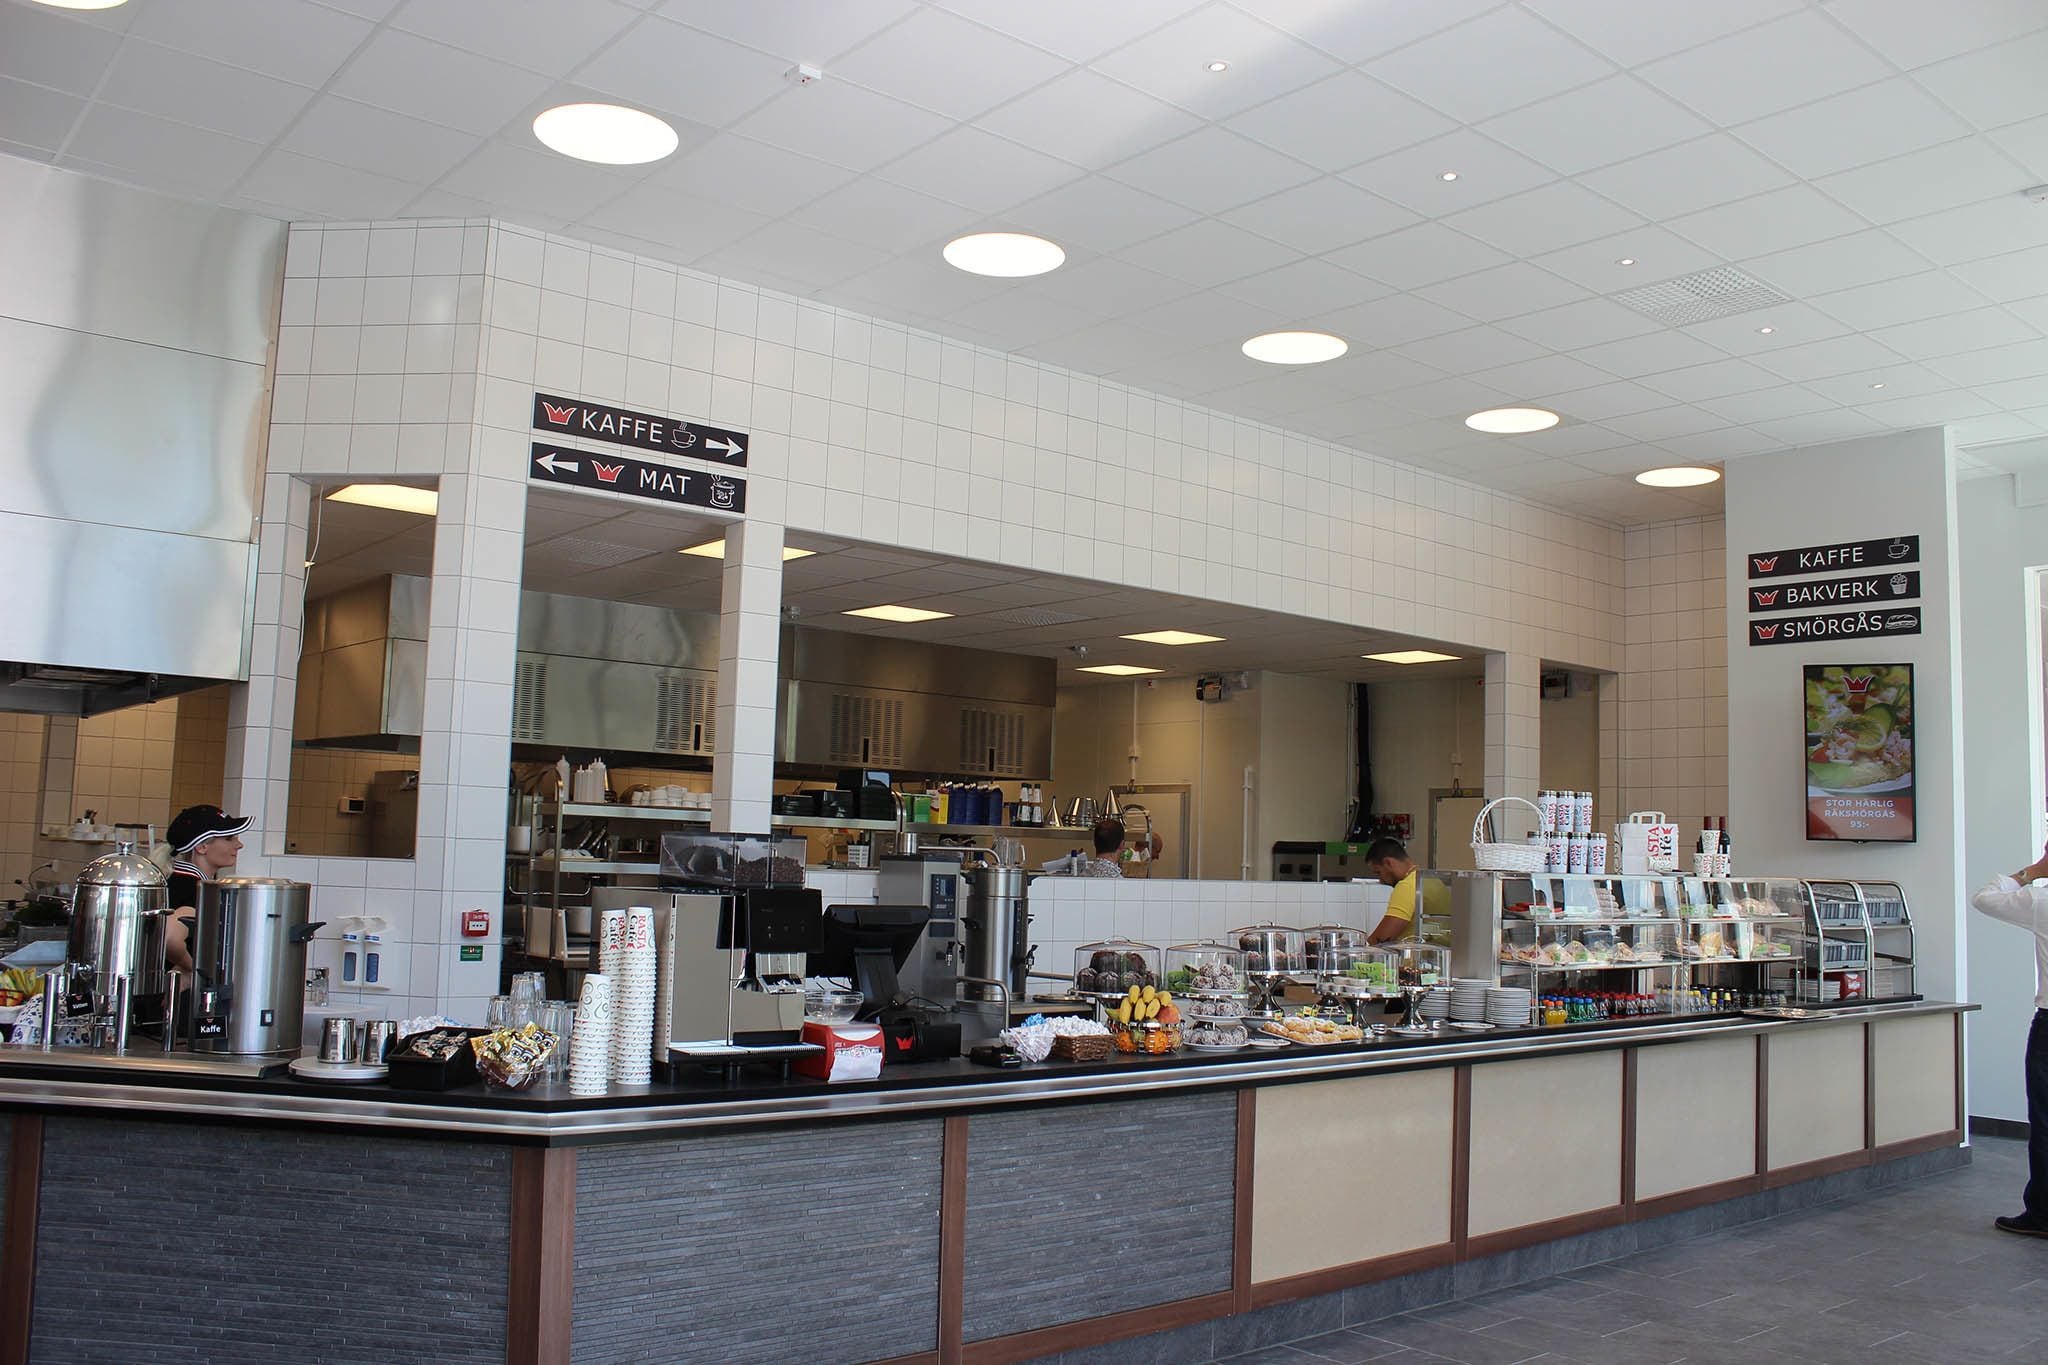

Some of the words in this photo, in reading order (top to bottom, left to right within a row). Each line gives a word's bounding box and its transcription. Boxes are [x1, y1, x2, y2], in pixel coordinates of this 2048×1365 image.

[582, 409, 664, 444] KAFFE
[639, 468, 692, 496] MAT
[1799, 546, 1864, 568] KAFFE
[1787, 579, 1879, 604] BAKVERK
[1783, 611, 1883, 638] SMÖRGÅS
[1825, 799, 1852, 808] STOR
[610, 917, 620, 944] Café
[629, 915, 638, 943] Café
[637, 915, 646, 950] RASTA
[200, 1024, 221, 1034] Kaffe
